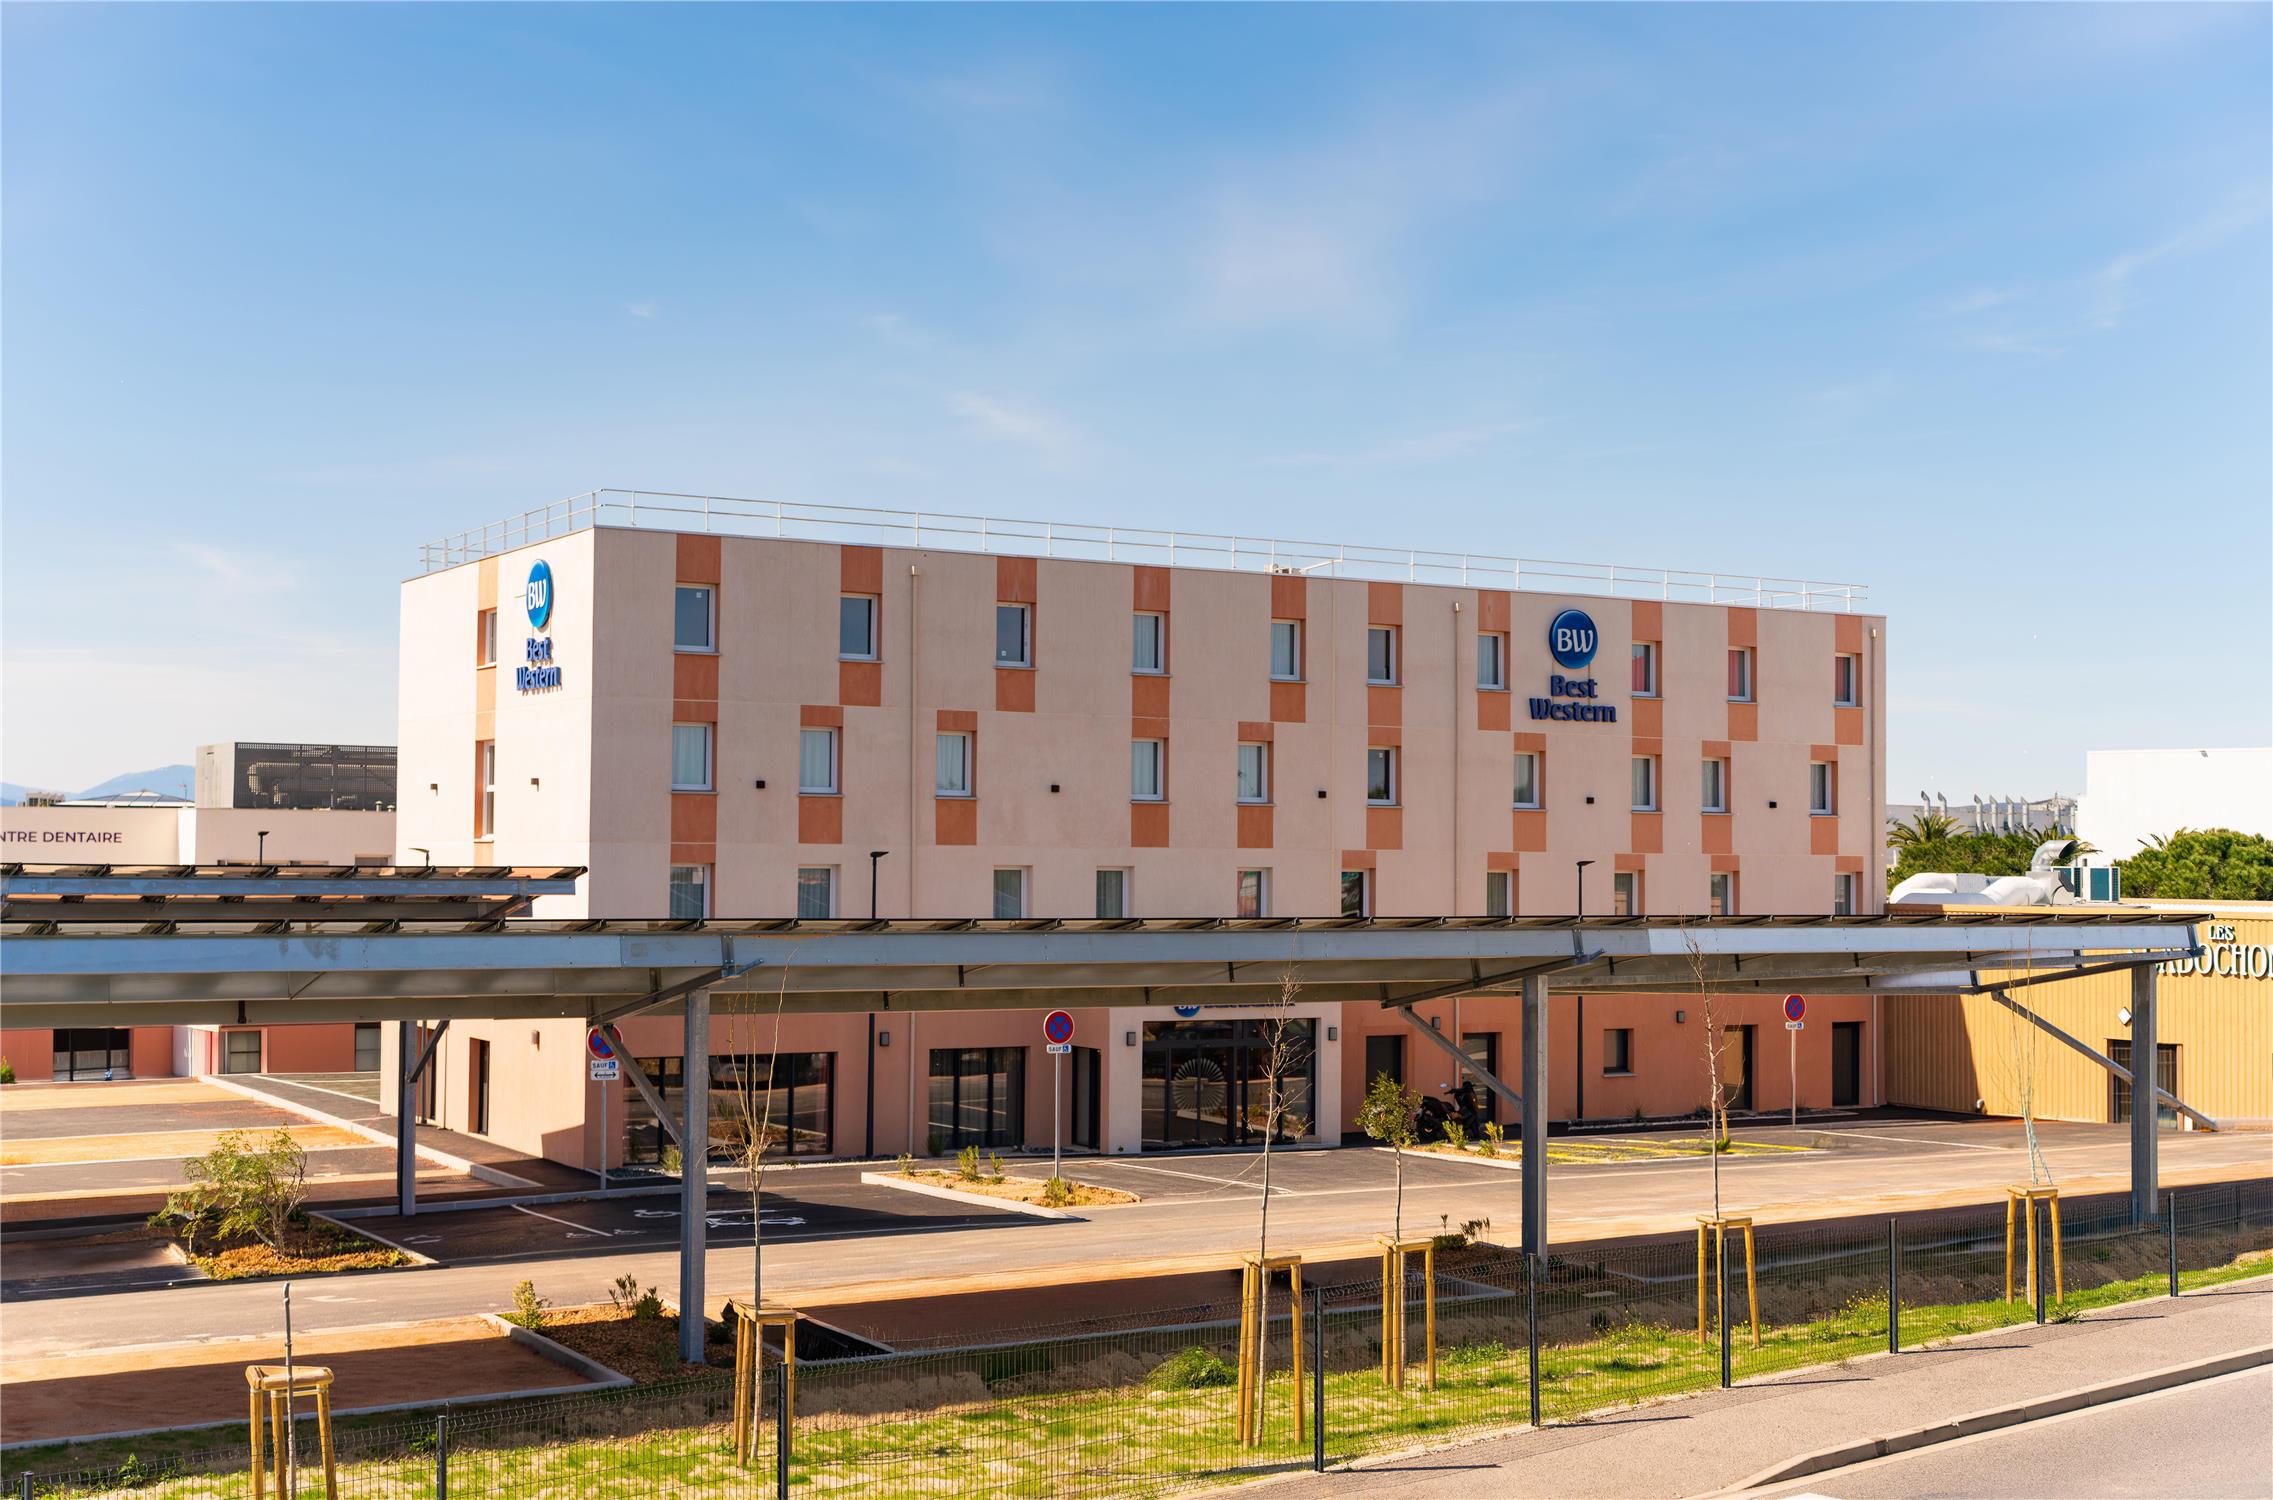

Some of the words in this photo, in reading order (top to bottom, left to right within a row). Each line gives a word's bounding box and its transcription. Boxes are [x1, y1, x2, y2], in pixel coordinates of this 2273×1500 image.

[527, 578, 547, 611] BW
[526, 637, 552, 662] Best
[1557, 628, 1594, 653] BW
[516, 666, 562, 691] Western
[1550, 675, 1598, 698] Best
[1529, 698, 1617, 723] Western
[43, 831, 123, 843] DENTAIRE
[2208, 925, 2235, 941] LES
